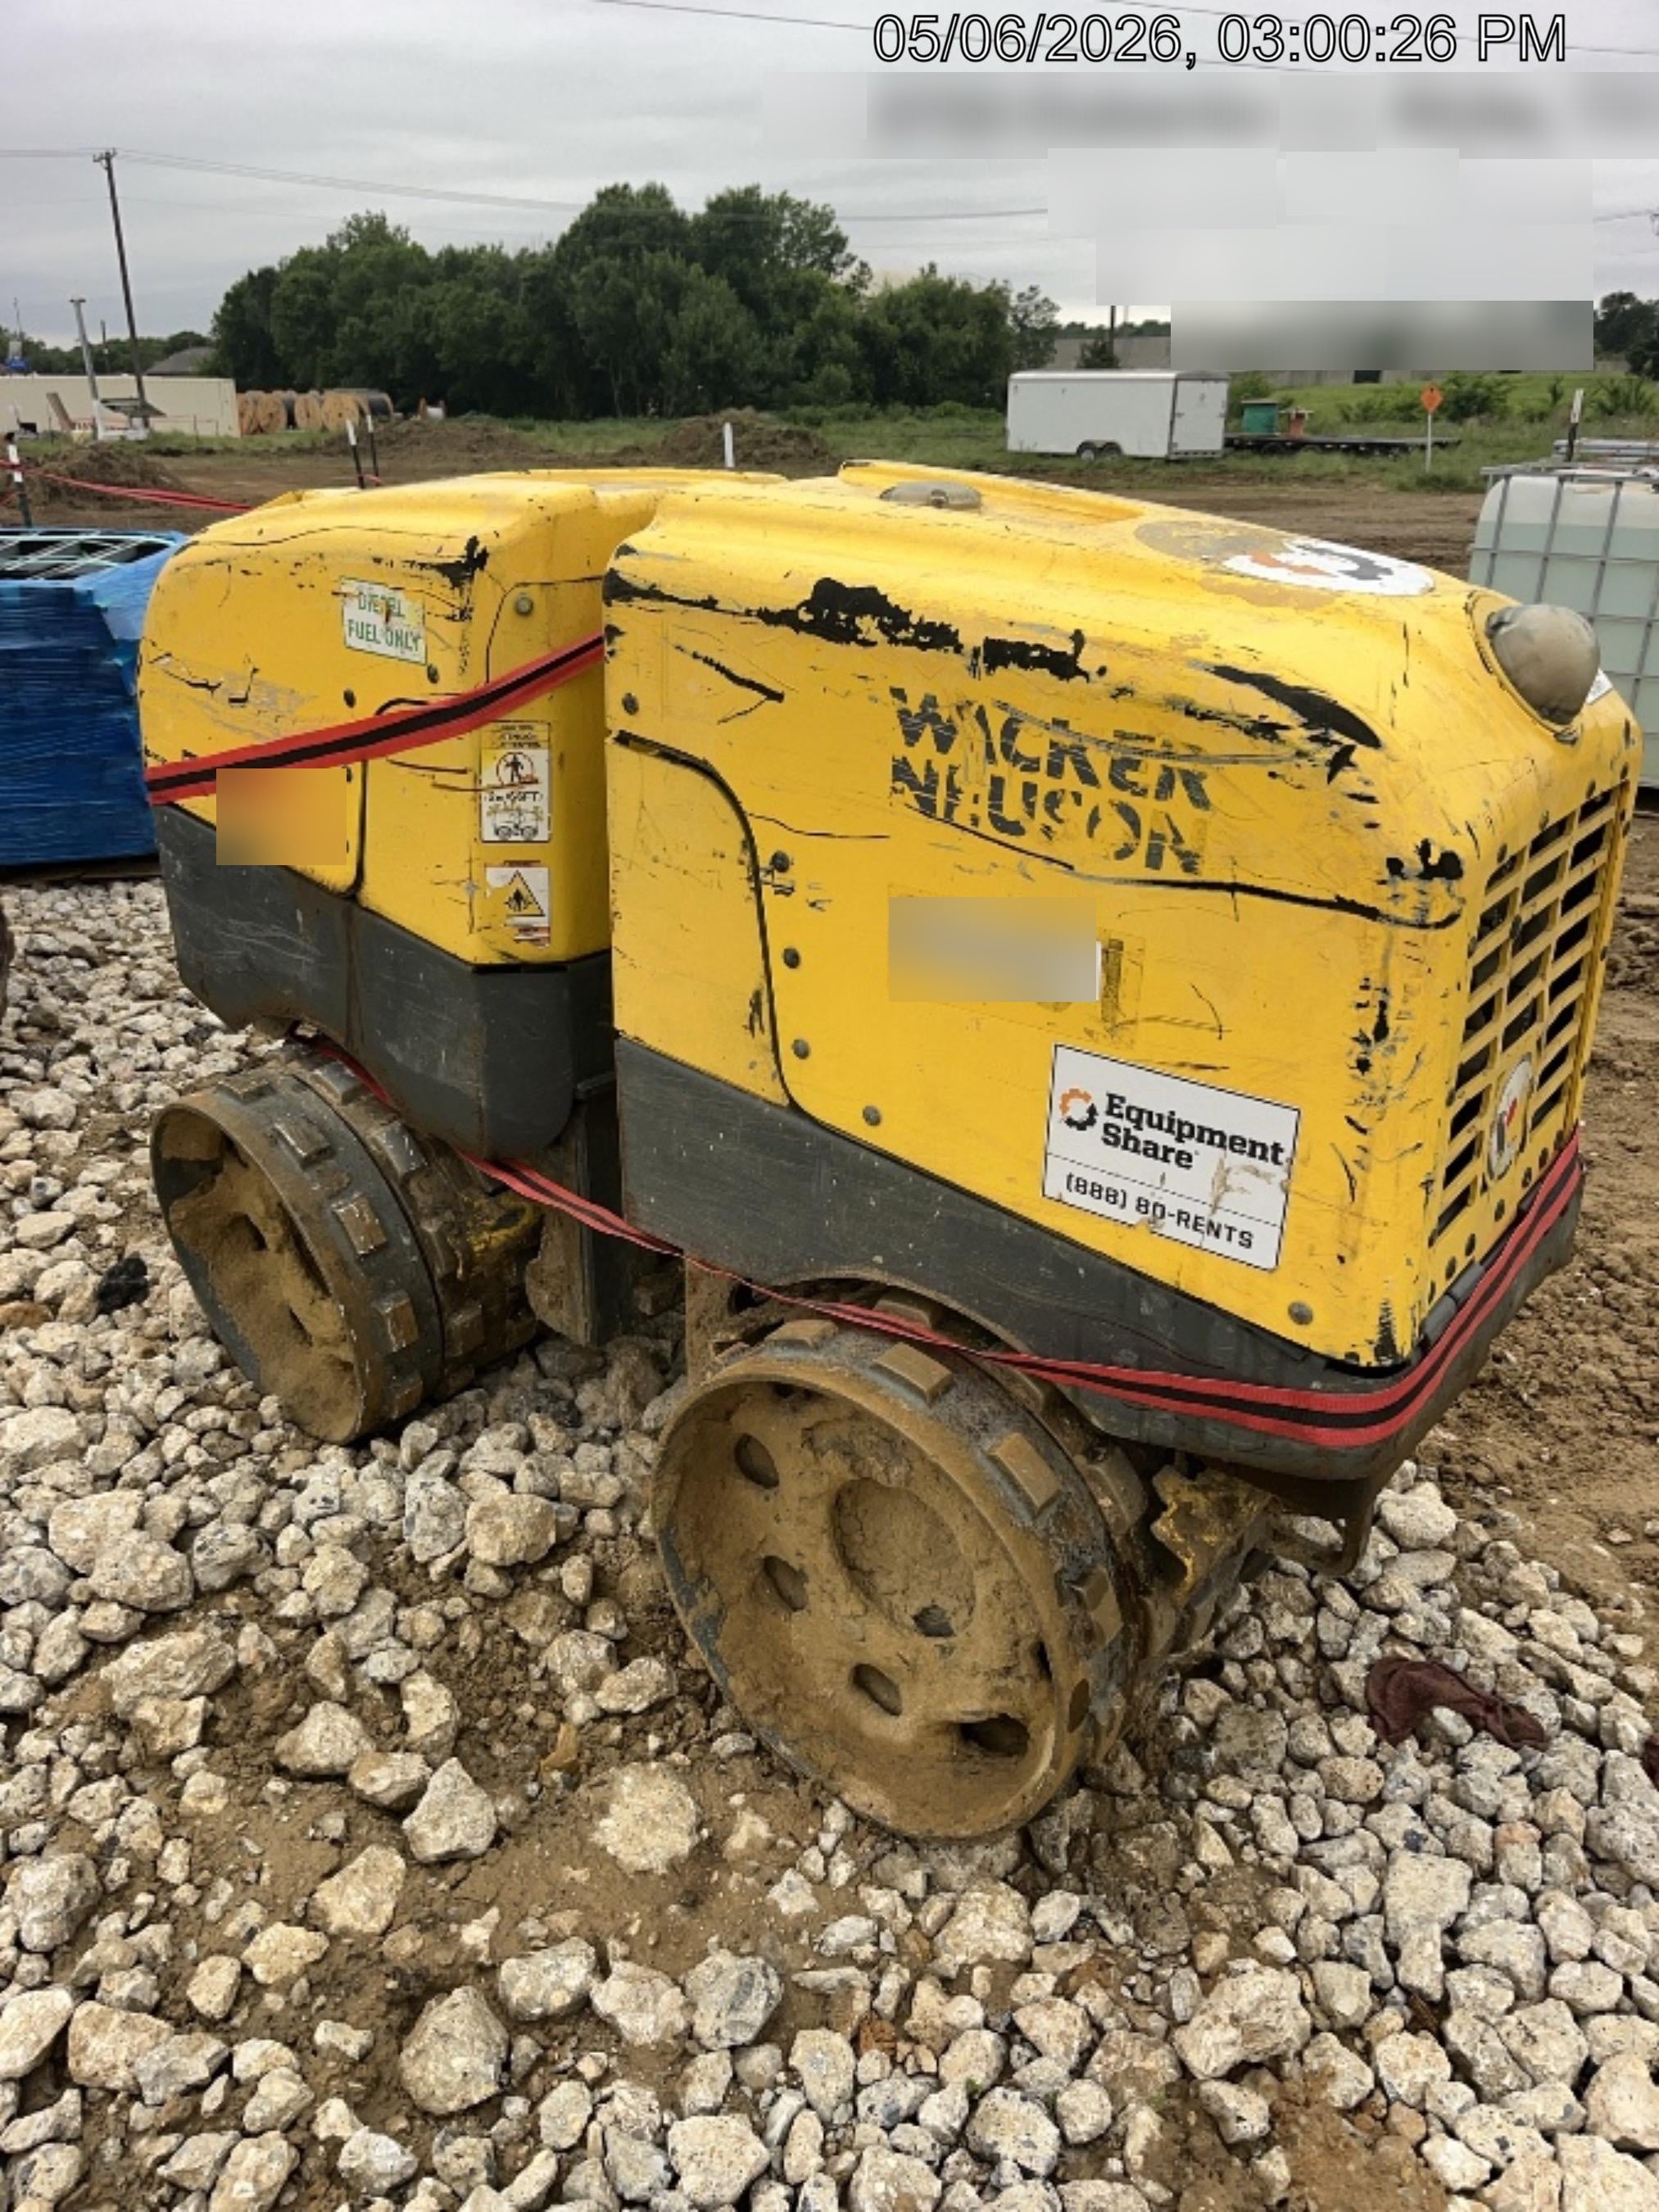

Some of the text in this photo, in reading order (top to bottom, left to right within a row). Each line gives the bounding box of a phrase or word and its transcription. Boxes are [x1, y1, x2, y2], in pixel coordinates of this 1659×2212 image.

[348, 619, 422, 651] FUEL ONLY
[1101, 1122, 1194, 1169] Share
[1104, 1093, 1285, 1165] Equipment
[1066, 1172, 1254, 1249] (888) 80-RENTS
